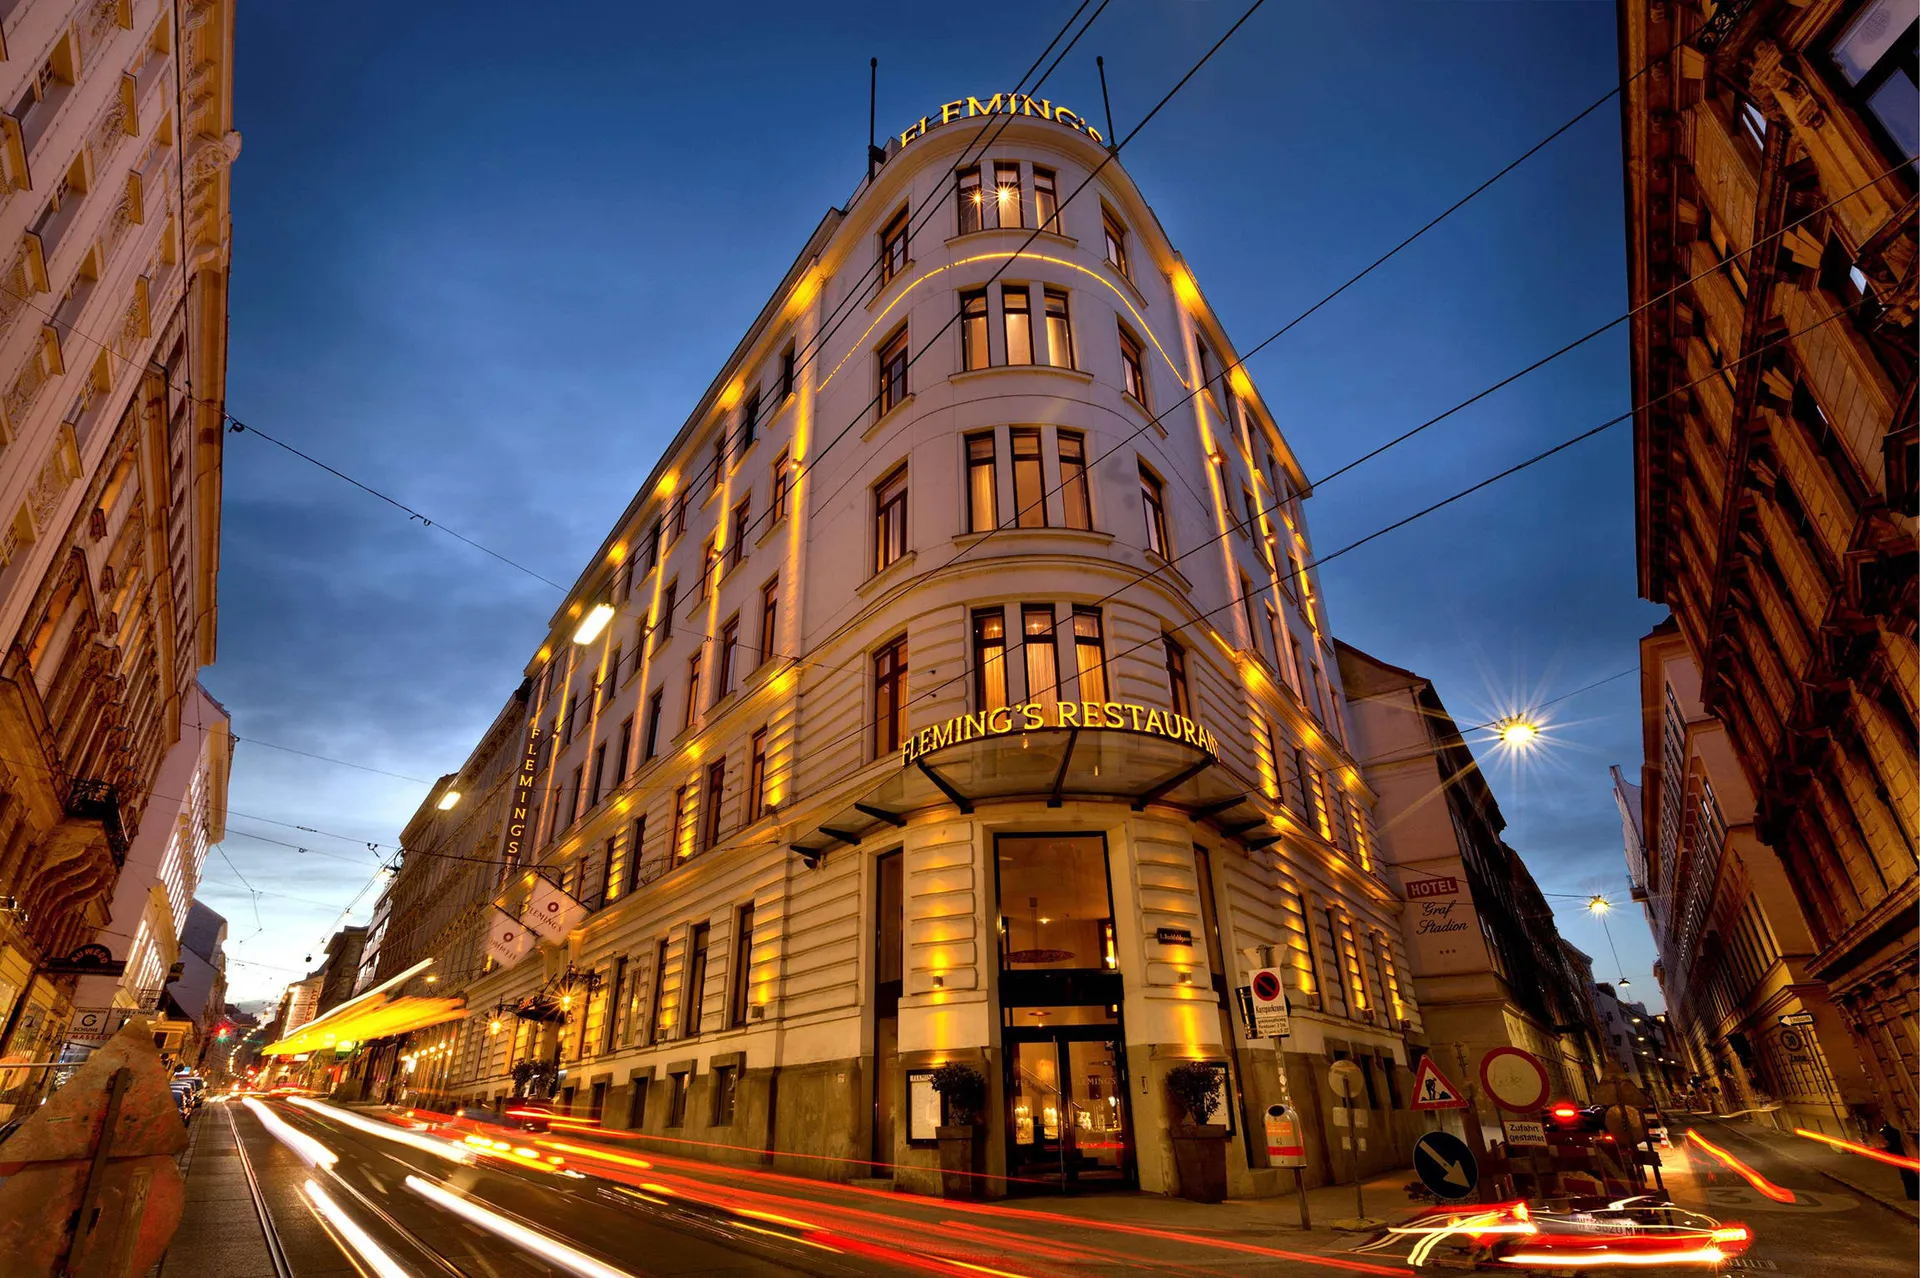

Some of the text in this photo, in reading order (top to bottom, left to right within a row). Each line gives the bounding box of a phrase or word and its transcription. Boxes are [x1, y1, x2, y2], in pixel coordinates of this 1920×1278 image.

[900, 701, 1221, 766] FLEMING'S RESTAURANT
[1411, 880, 1456, 896] HOTEL
[1421, 899, 1457, 919] Graf
[1416, 919, 1468, 935] Stadion
[81, 1014, 97, 1026] G
[1785, 1035, 1796, 1046] 30
[1509, 1124, 1539, 1133] Zufahrt
[1509, 1133, 1545, 1142] gestattet
